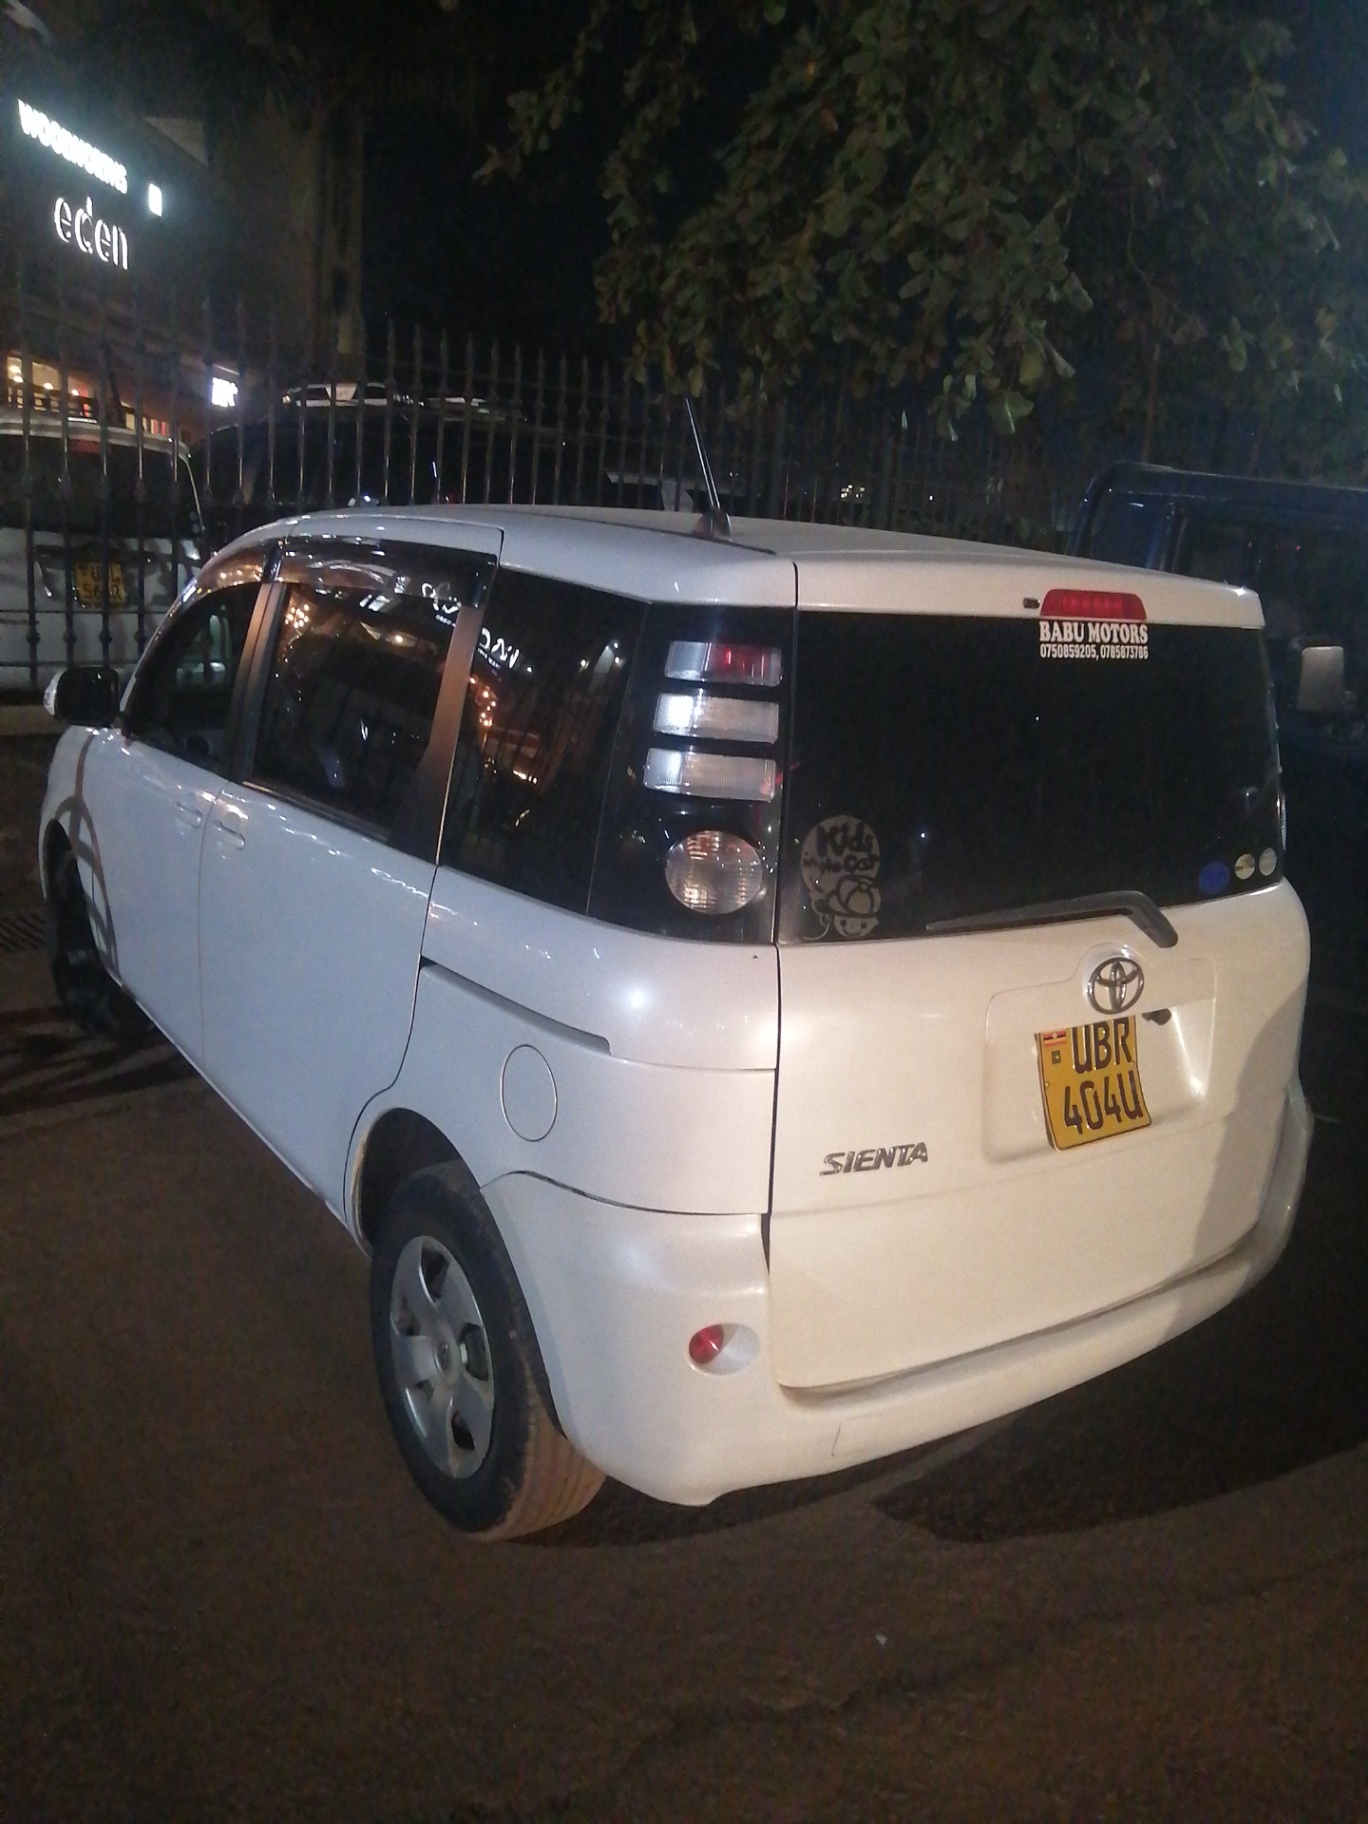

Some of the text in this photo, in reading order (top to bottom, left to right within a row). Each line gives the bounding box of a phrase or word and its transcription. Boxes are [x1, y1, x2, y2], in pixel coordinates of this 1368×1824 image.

[54, 197, 128, 270] eden
[1039, 621, 1148, 644] BABU MOTORS
[1072, 1017, 1132, 1074] UBR
[1064, 1070, 1143, 1134] 404U
[819, 1141, 928, 1175] SIENTA
